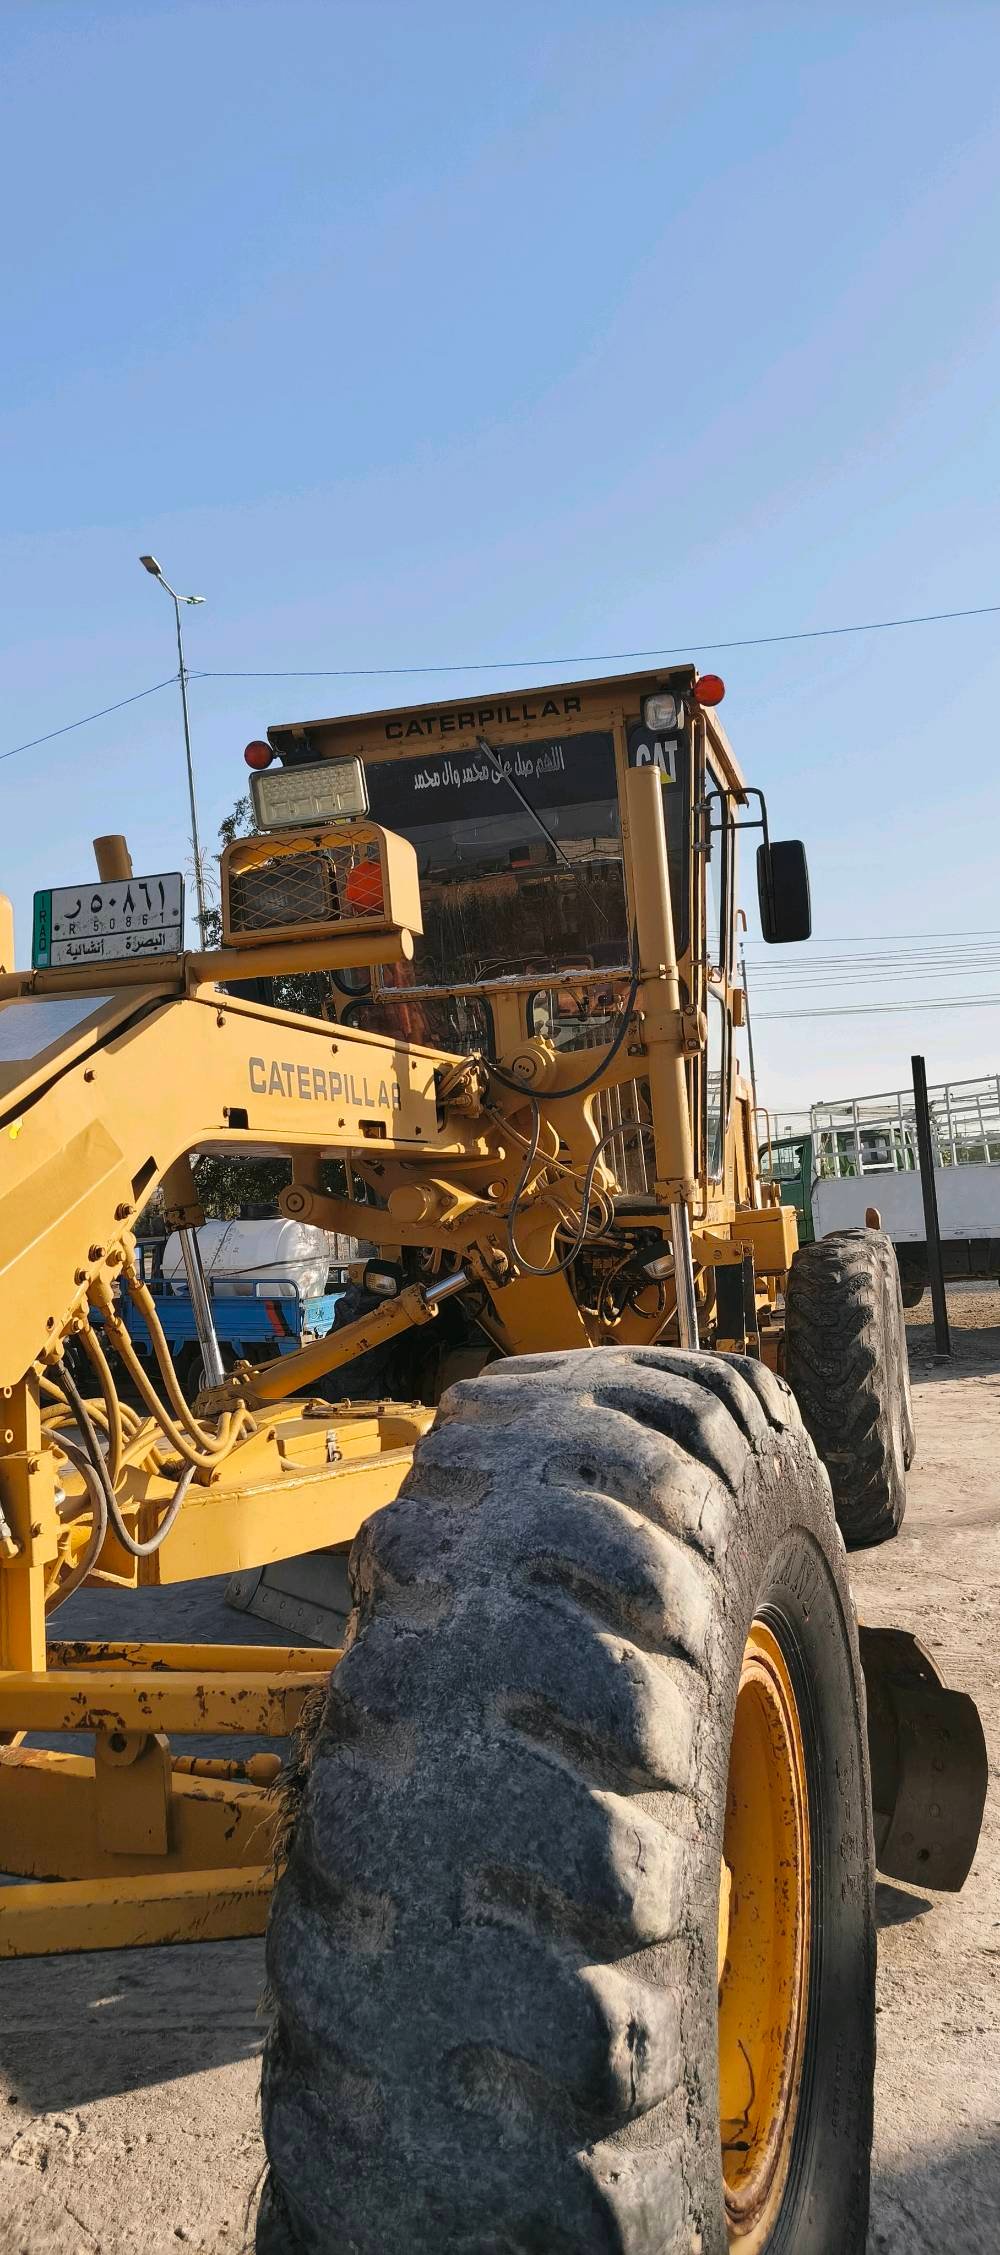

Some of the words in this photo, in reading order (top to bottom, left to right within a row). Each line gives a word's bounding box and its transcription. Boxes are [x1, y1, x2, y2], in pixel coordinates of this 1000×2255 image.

[384, 696, 582, 740] CATERPILLAR
[462, 762, 489, 785] محمد
[491, 753, 513, 784] على
[535, 745, 565, 778] اللهم
[636, 740, 677, 784] CAT
[414, 769, 440, 790] محمد
[125, 933, 165, 953] البصرة
[249, 1056, 401, 1111] CATERPILLAR
